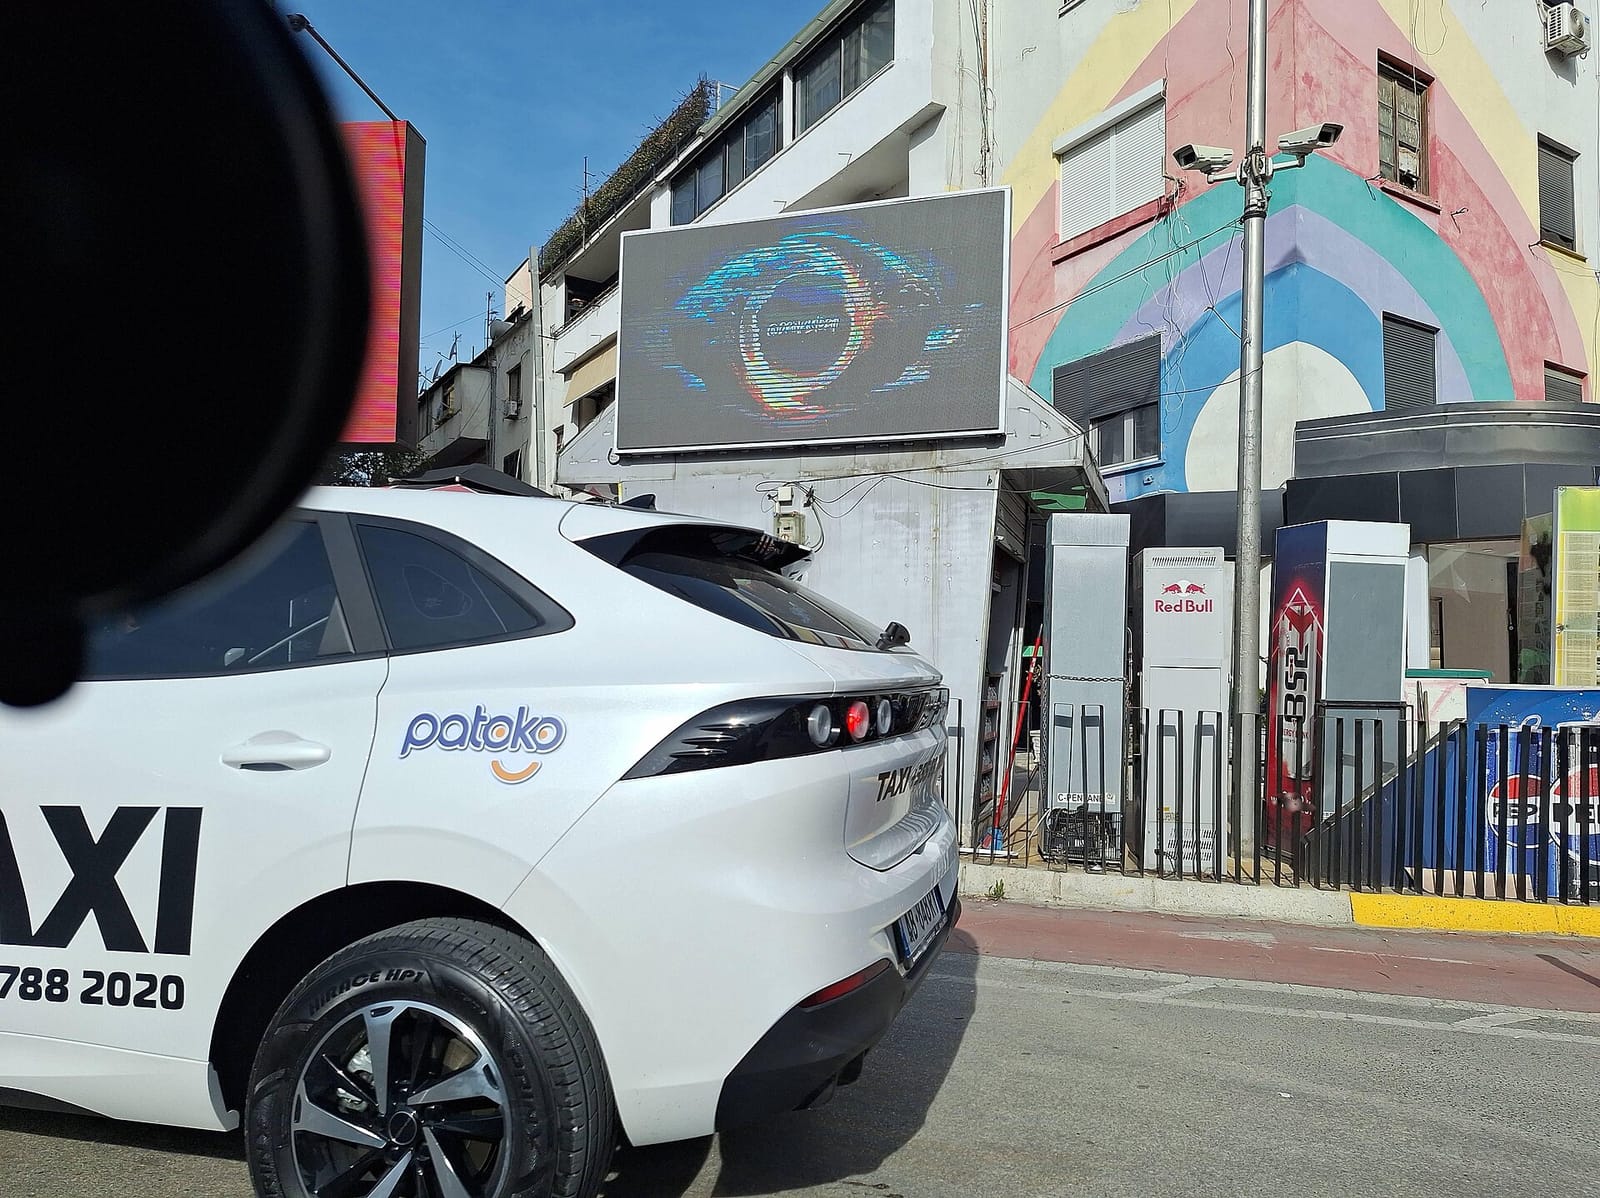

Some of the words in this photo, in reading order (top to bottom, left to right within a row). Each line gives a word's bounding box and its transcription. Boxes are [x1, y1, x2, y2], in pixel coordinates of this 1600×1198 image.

[1154, 599, 1183, 613] Red
[1185, 599, 1213, 613] Bull
[399, 704, 565, 757] patoko
[877, 766, 912, 802] TAXI
[1057, 793, 1102, 803] C-PENAN
[0, 965, 69, 1003] 788
[79, 970, 185, 1010] 2020
